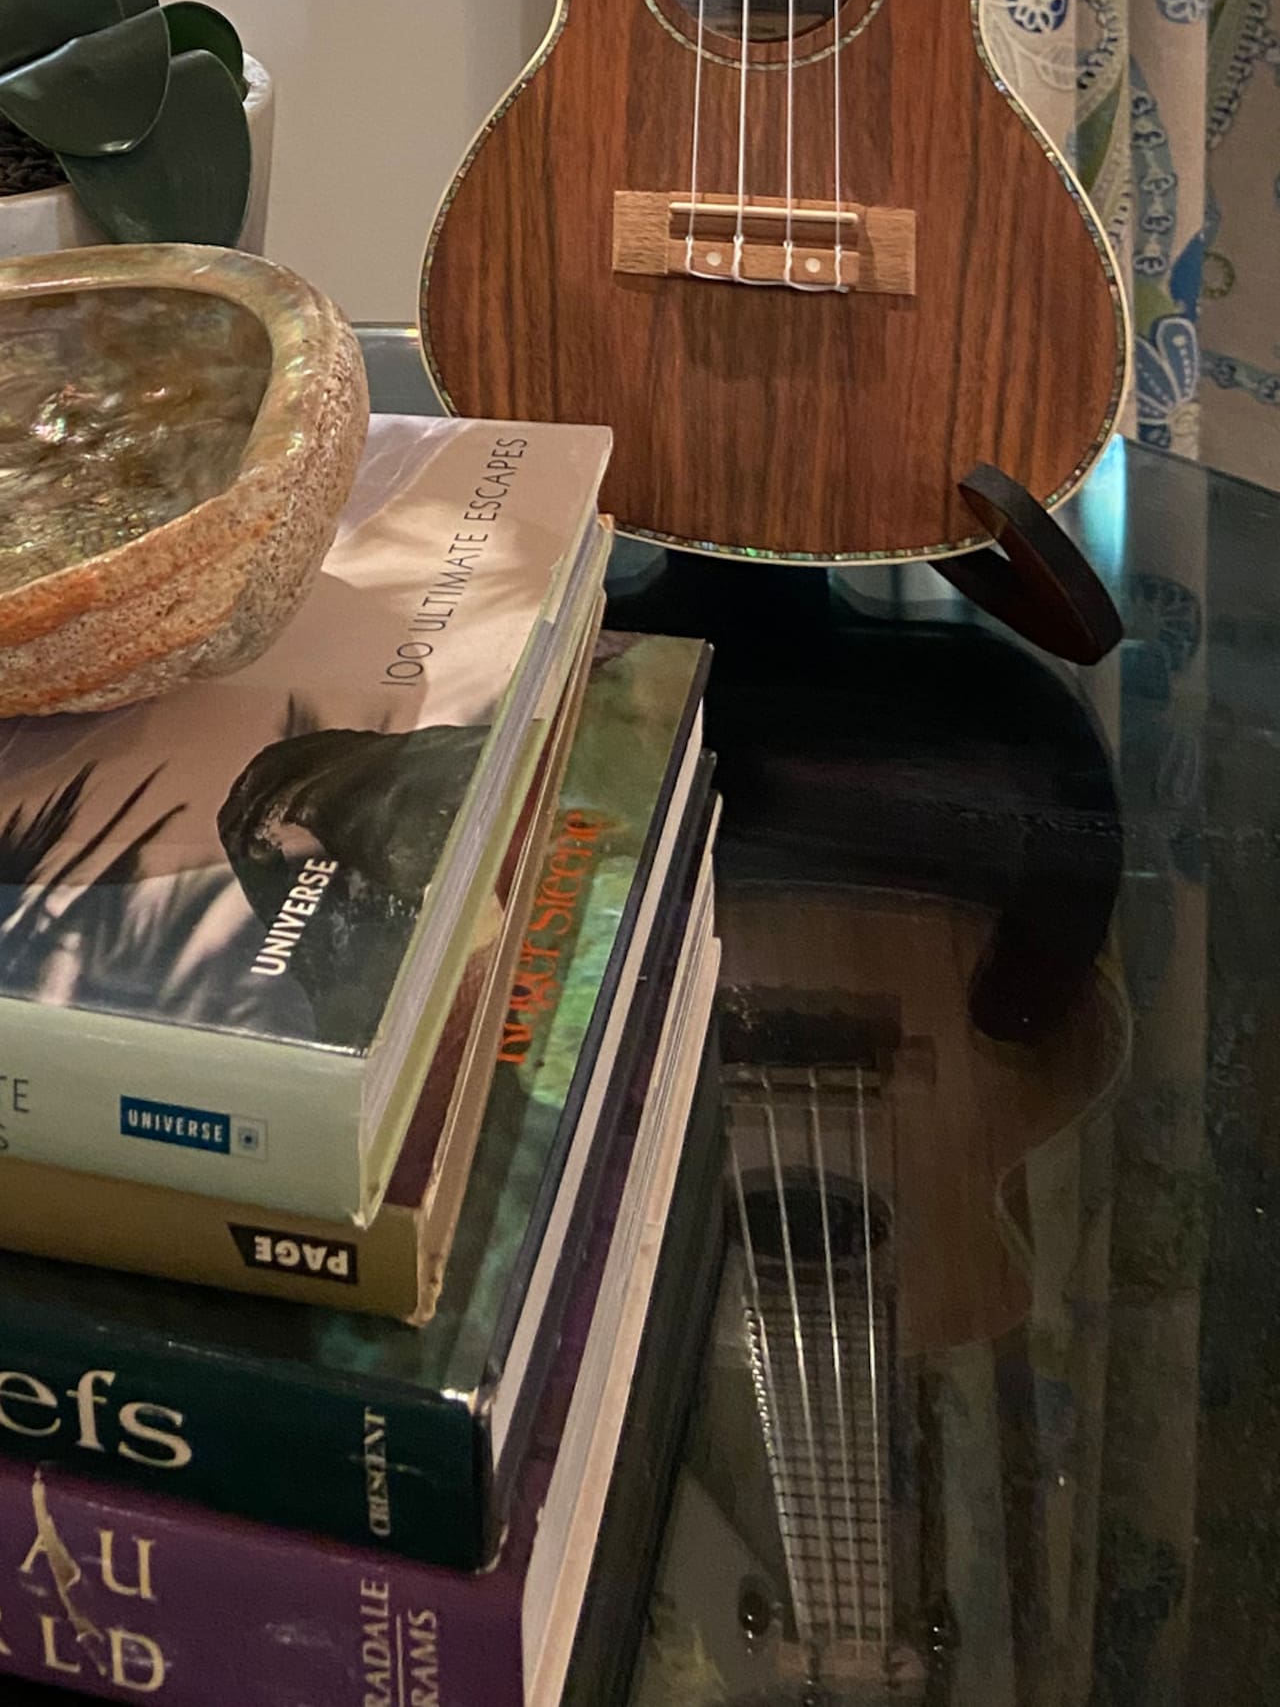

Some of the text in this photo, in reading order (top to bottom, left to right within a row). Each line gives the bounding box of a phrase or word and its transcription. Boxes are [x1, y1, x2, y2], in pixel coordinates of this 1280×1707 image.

[380, 438, 528, 686] 100 ULTIMATE ESCAPES
[251, 858, 339, 977] UNIVERSE
[127, 1109, 225, 1143] UNIVERSE
[254, 1235, 349, 1276] PAGE
[360, 1578, 391, 1707] RADALE
[408, 1608, 440, 1707] RAMS
